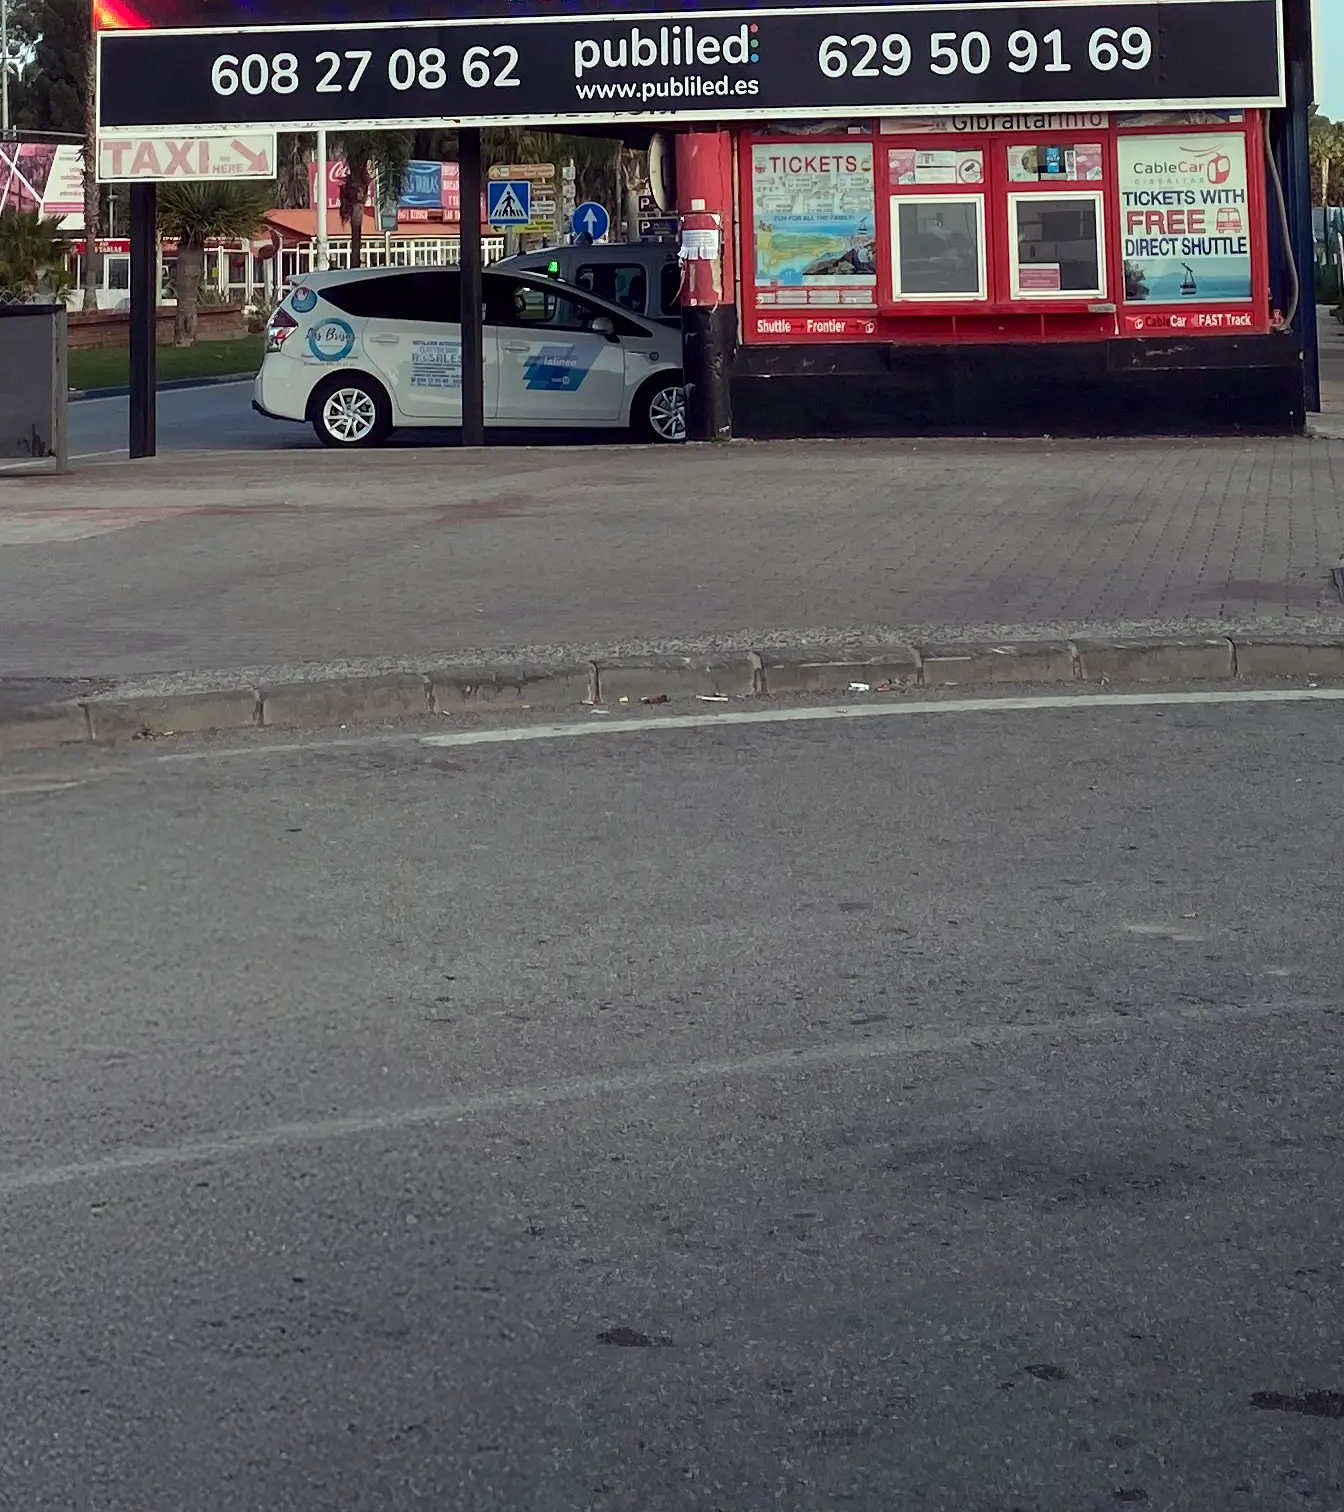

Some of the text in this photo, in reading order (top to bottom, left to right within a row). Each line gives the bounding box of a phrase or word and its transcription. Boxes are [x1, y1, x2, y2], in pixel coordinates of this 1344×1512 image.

[818, 26, 1152, 78] 629 50 91 69
[211, 45, 521, 96] 608 27 08 62
[575, 74, 760, 102] www.publiled.es
[103, 140, 244, 176] TAXI HERE
[769, 155, 857, 173] TICKETS
[1133, 161, 1205, 174] CableCar
[1122, 189, 1245, 206] TICKETS WITH
[1126, 209, 1207, 236] FREE
[1125, 236, 1248, 257] DIRECT SHUTTLE
[757, 319, 846, 333] Shuttle Frontier
[1199, 313, 1224, 327] FAST
[1226, 312, 1252, 326] Track
